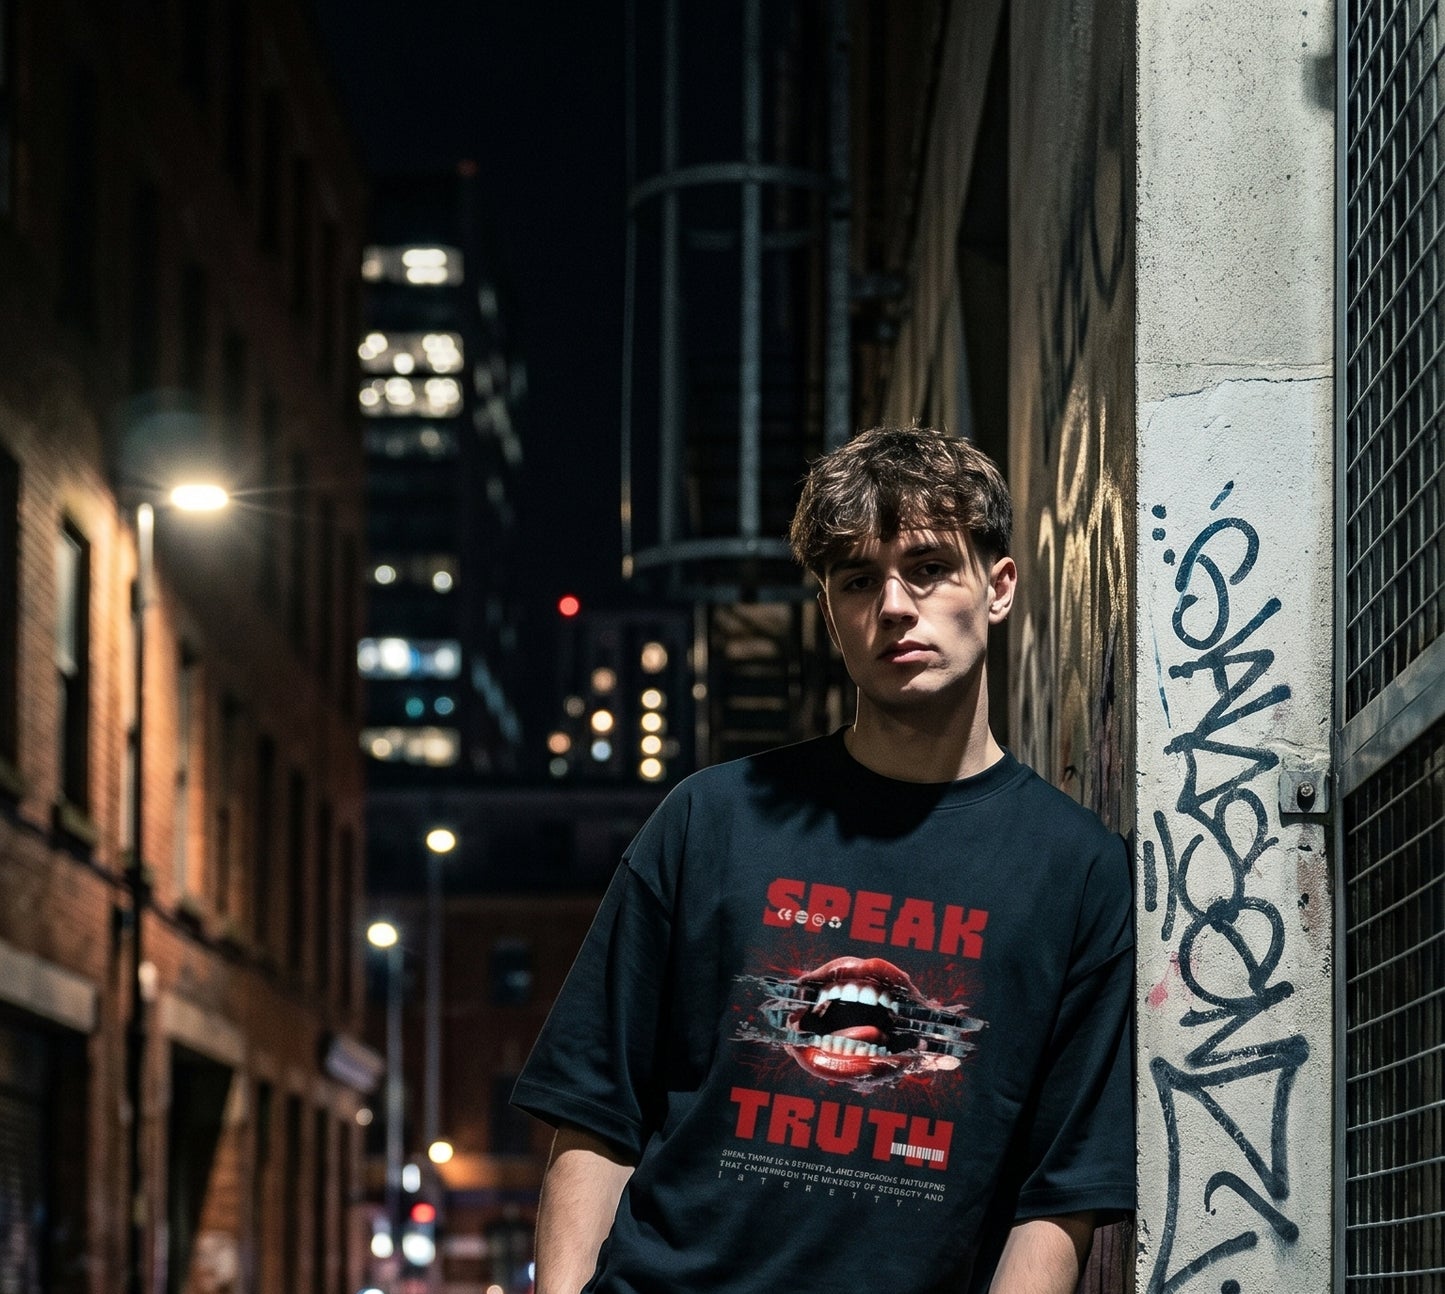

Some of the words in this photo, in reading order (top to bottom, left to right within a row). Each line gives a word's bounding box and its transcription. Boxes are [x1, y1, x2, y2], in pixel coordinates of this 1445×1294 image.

[763, 878, 988, 959] SPEAK
[730, 1087, 954, 1170] TRUTH
[718, 1159, 742, 1169] THAT
[800, 1172, 819, 1182] THE
[862, 1182, 876, 1191] OF
[923, 1192, 944, 1202] AND
